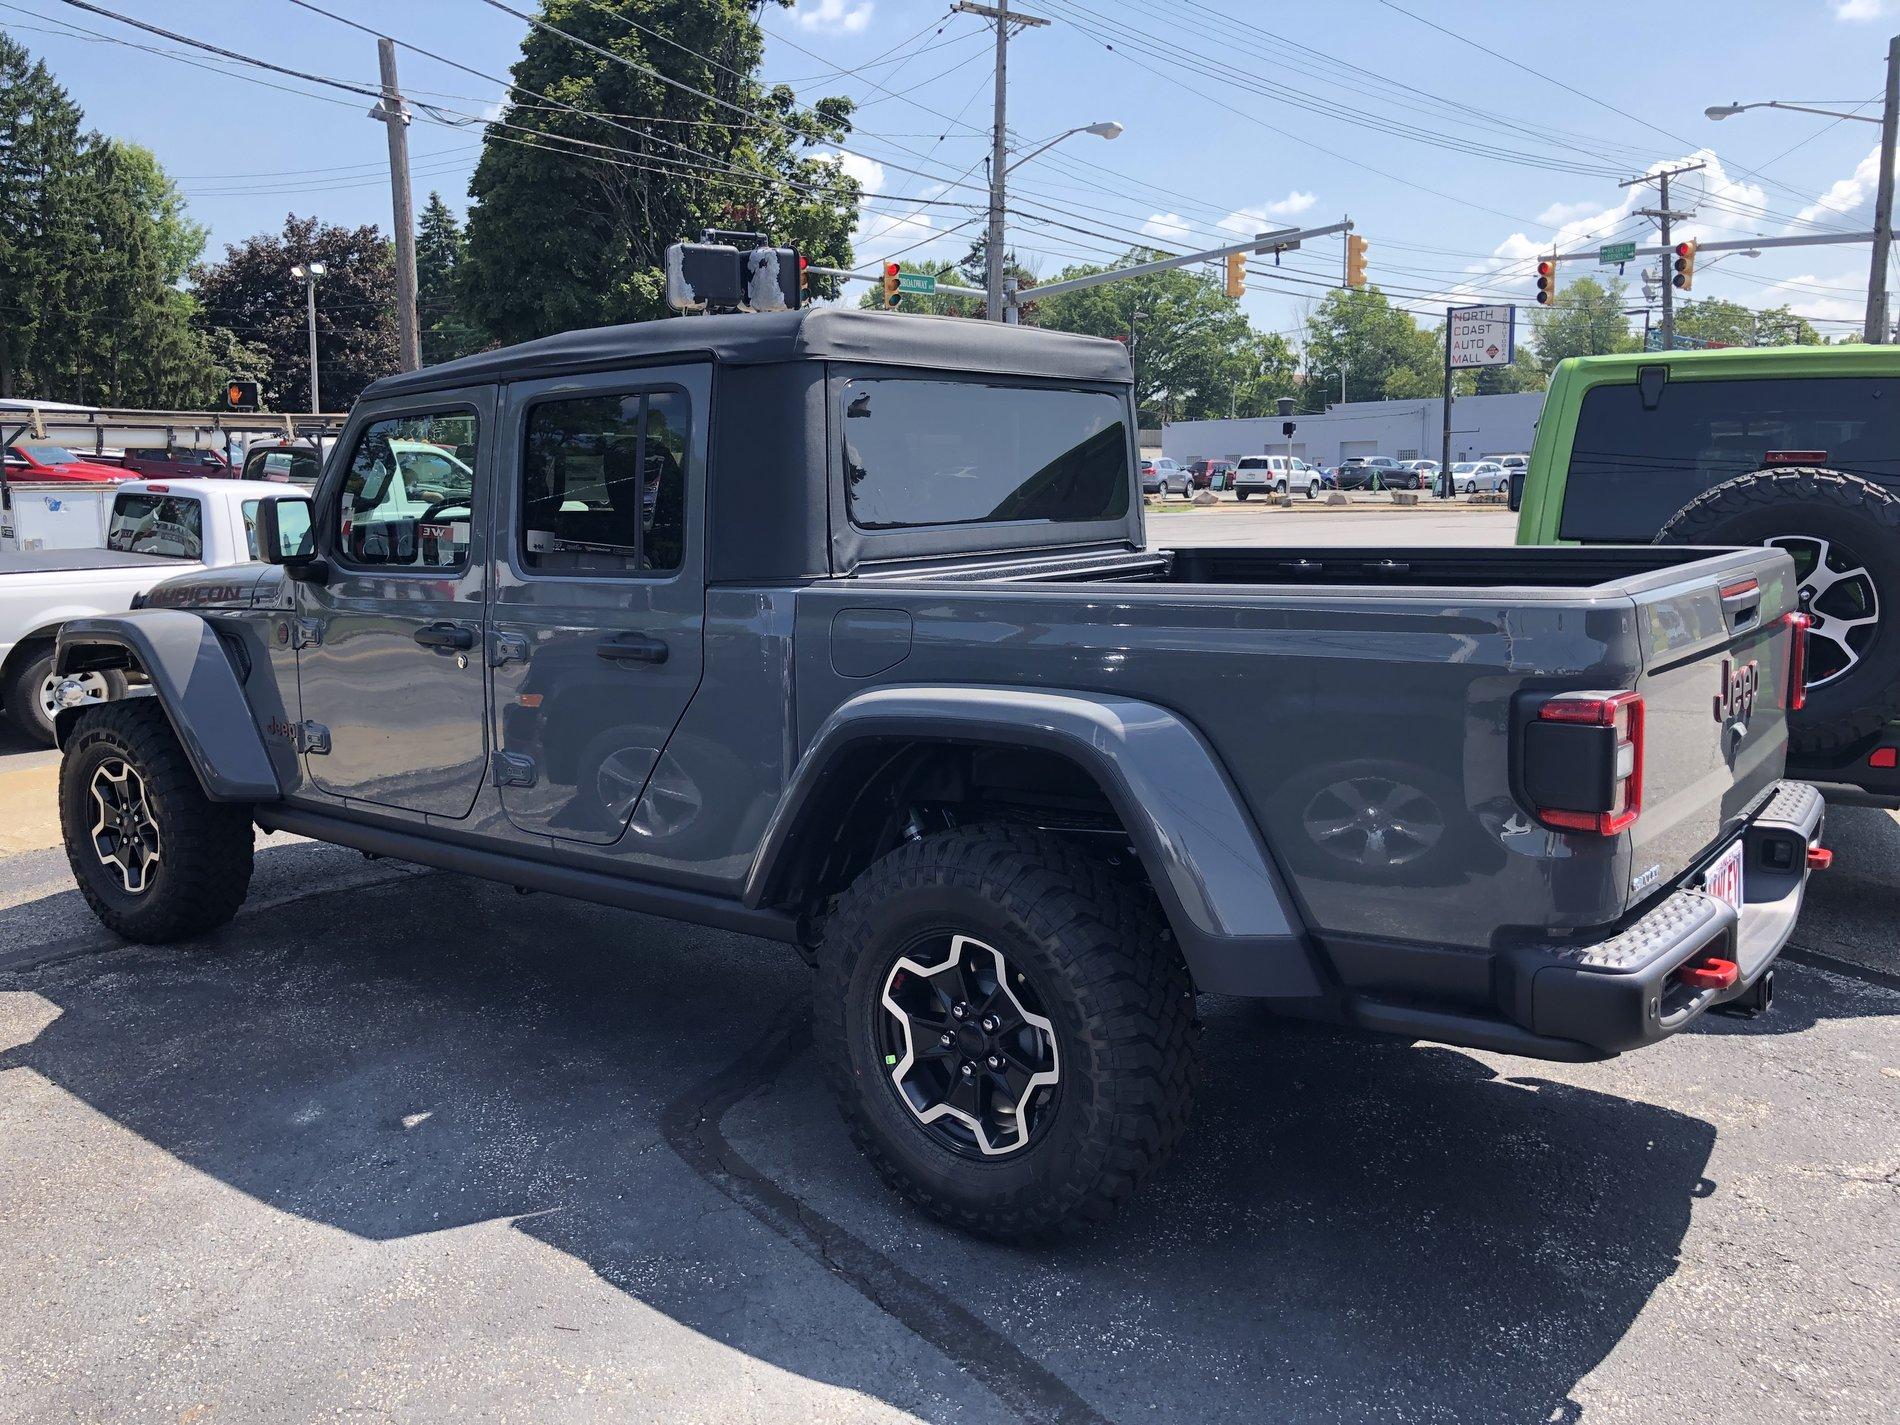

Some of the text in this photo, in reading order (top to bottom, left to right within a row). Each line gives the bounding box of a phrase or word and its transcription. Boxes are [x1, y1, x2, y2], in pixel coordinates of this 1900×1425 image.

[1454, 310, 1494, 322] NORTH
[1454, 324, 1492, 336] COAST
[1453, 339, 1485, 351] AUTO
[1452, 354, 1482, 364] MALL
[151, 585, 243, 604] RUBICON
[1713, 658, 1759, 723] Jeep
[267, 716, 298, 742] Jeep
